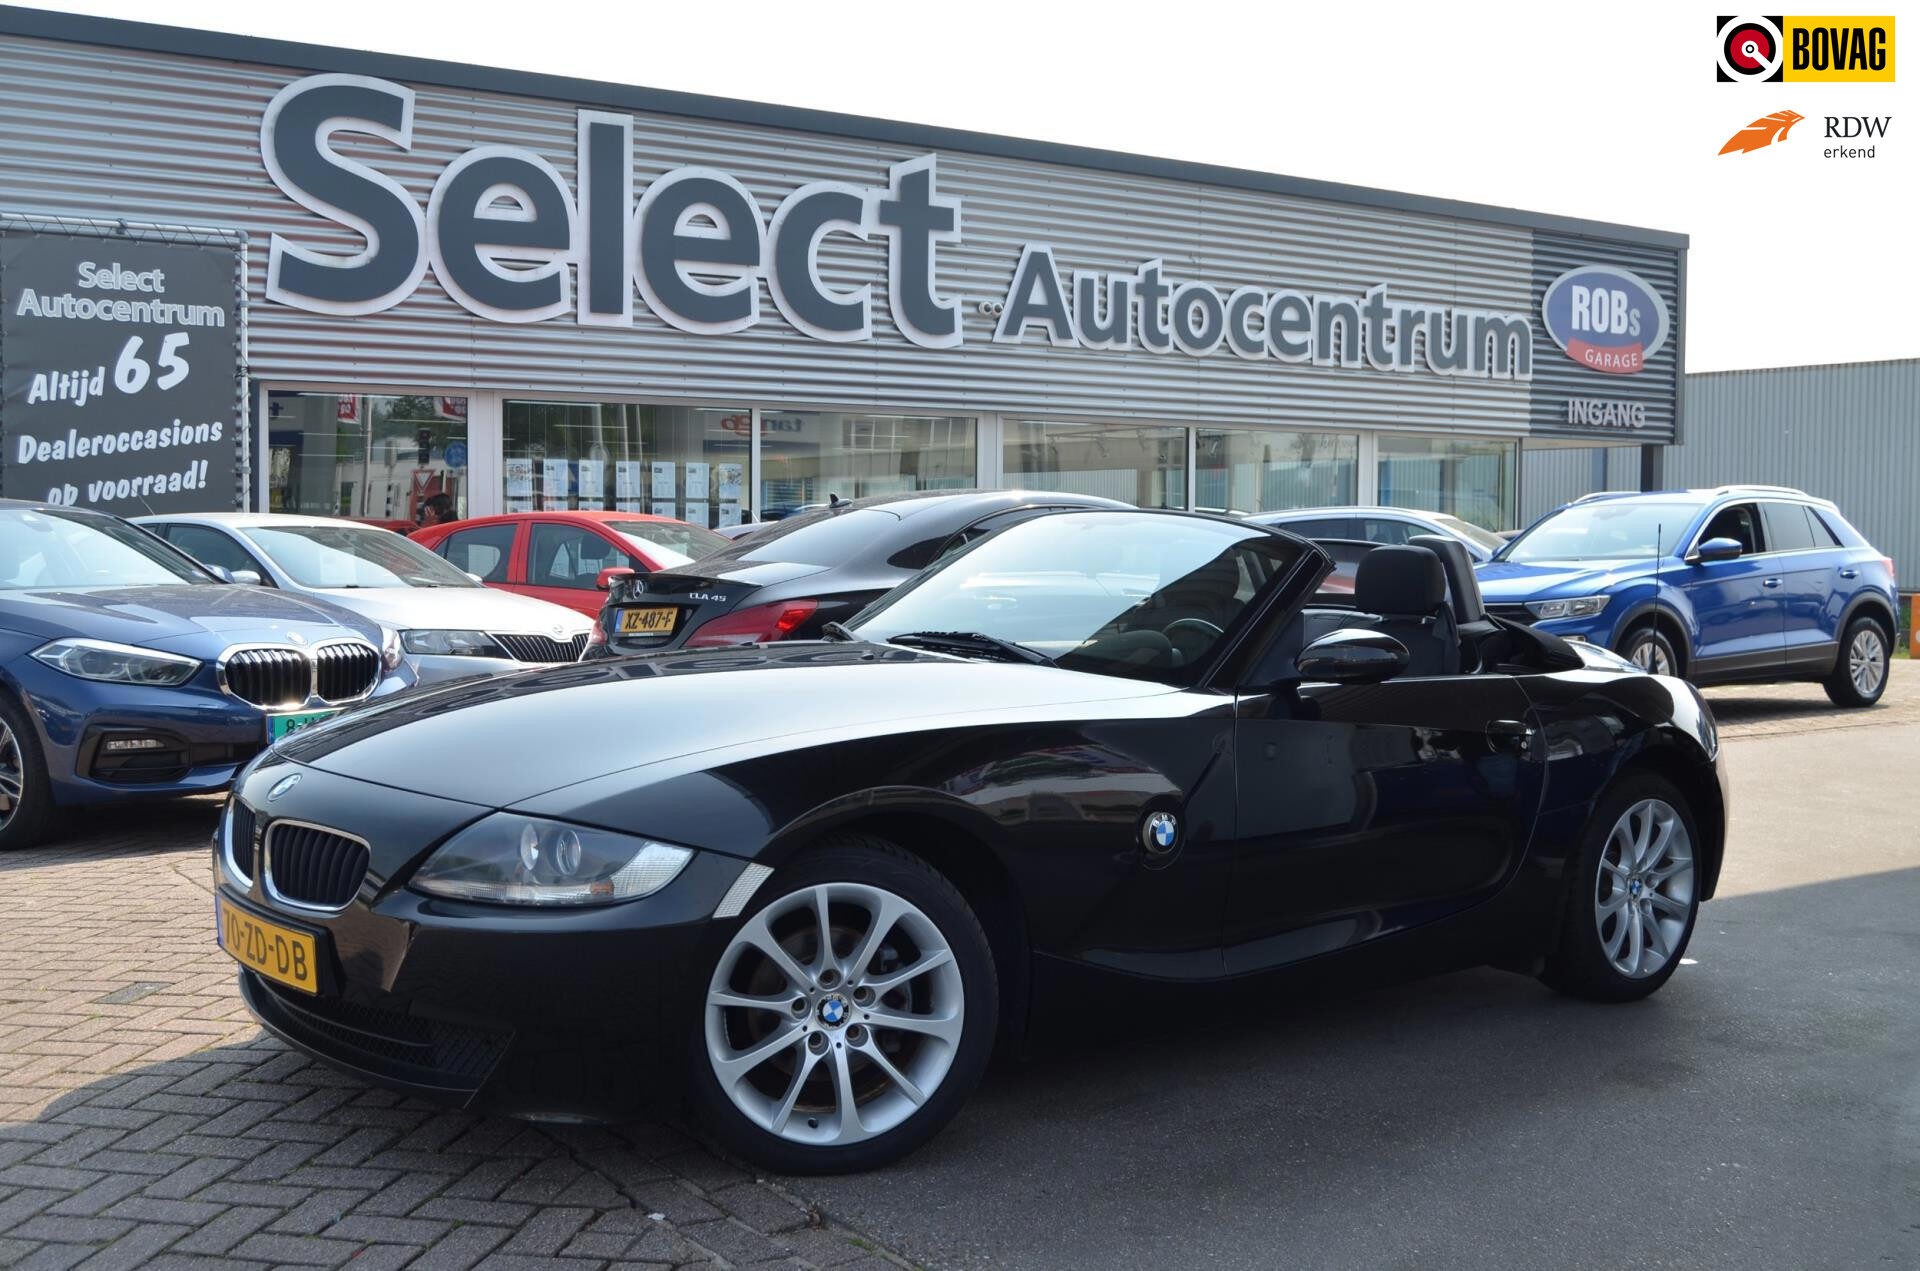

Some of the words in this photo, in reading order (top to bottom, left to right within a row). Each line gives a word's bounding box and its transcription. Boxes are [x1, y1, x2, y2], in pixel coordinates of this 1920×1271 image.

[261, 73, 963, 349] Select
[992, 242, 1532, 381] Autocentrum
[77, 261, 165, 293] Select
[16, 288, 225, 327] Autocentrum
[1571, 284, 1641, 337] ROBs
[27, 366, 106, 407] Altijd
[114, 331, 190, 394] 65
[1585, 348, 1638, 368] GARAGE
[1567, 399, 1646, 428] INGANG
[17, 418, 222, 464] Dealeroccasions
[48, 483, 79, 506] op
[87, 459, 208, 503] voorraad!
[624, 610, 673, 630] XZ-487-F
[223, 908, 307, 981] 70-ZD-DB
